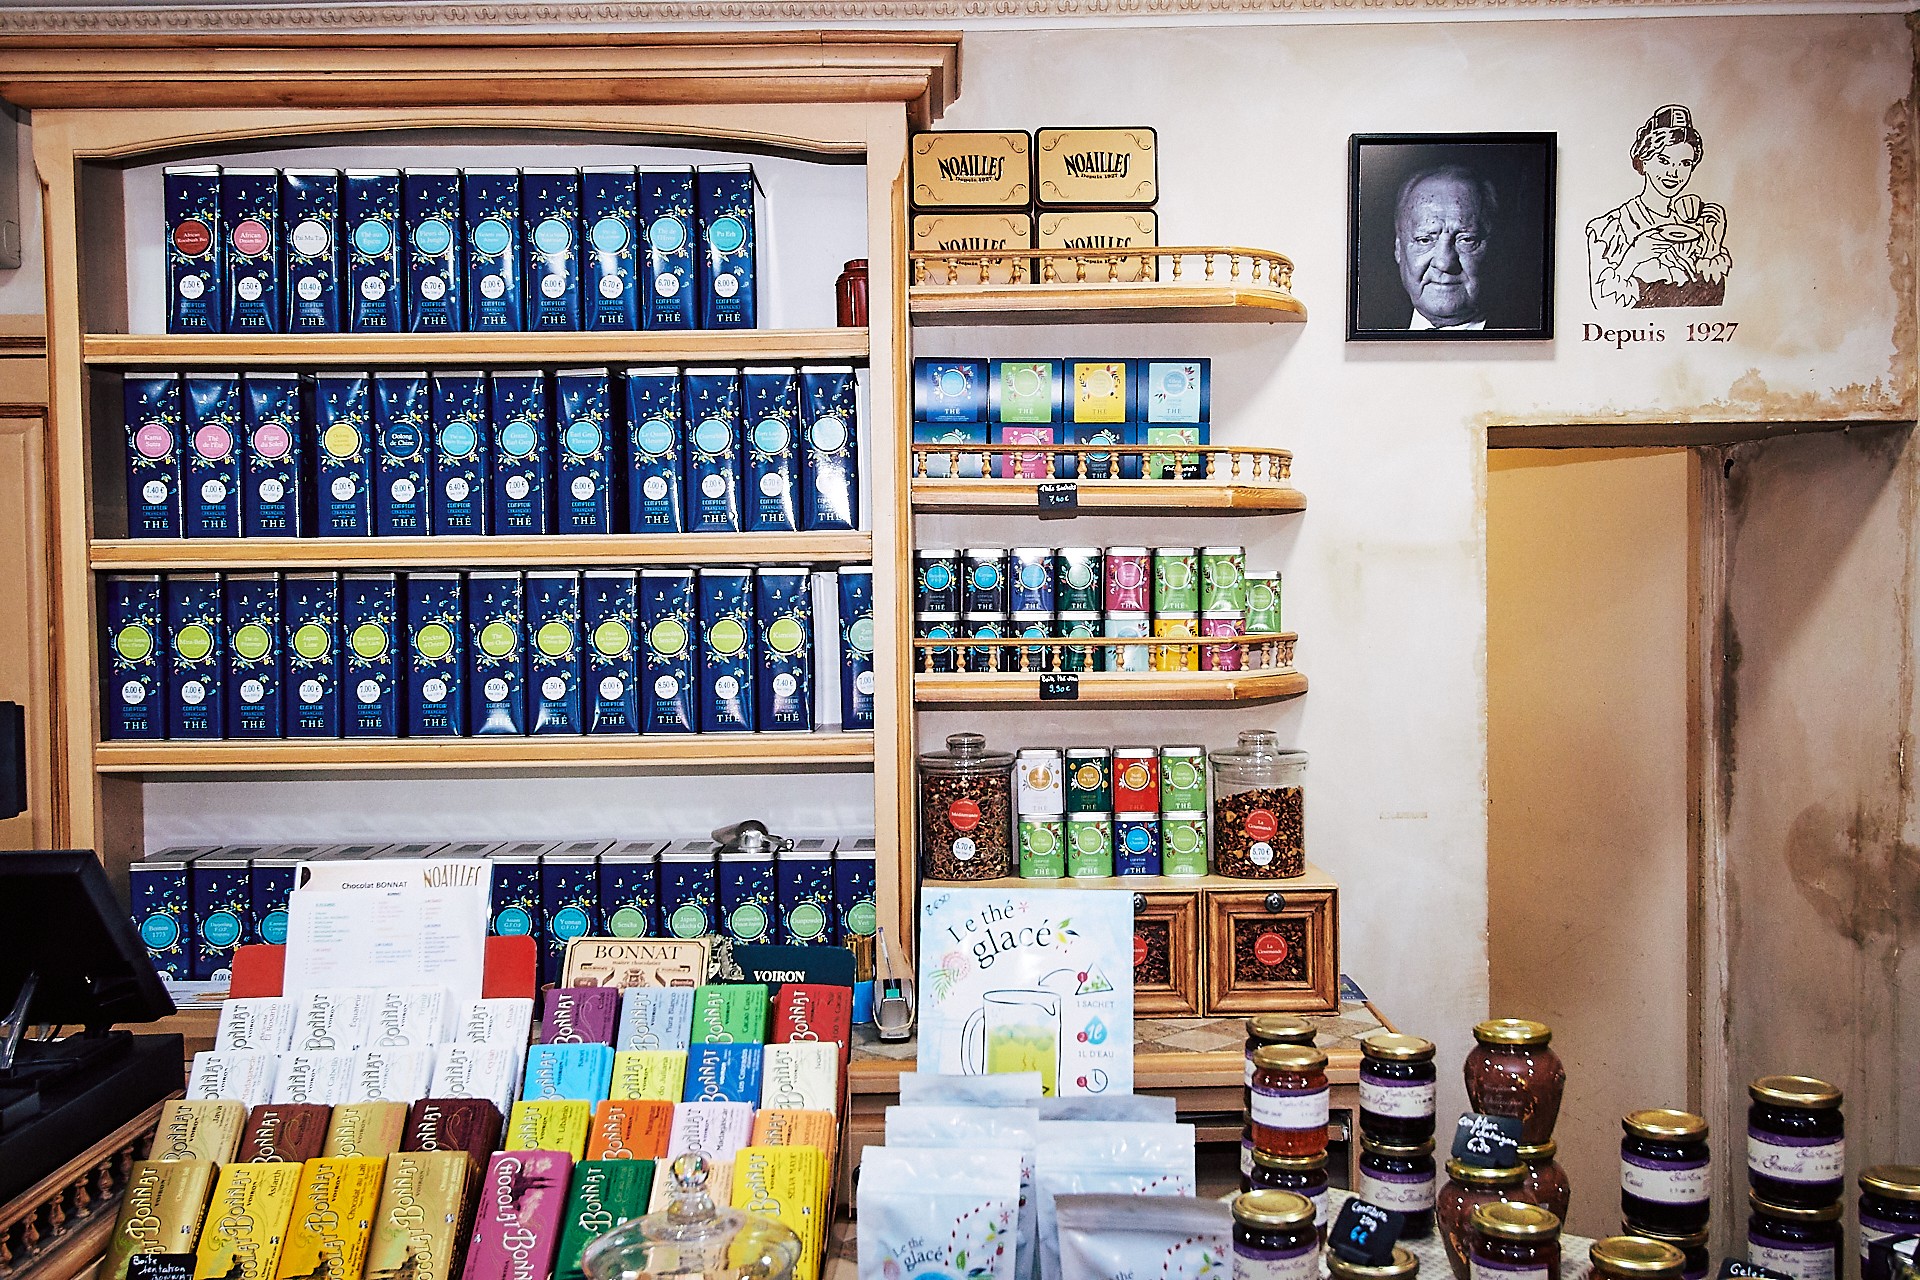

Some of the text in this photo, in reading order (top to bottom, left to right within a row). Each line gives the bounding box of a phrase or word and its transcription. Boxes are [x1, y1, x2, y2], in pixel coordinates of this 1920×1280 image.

[938, 155, 1005, 181] NOAILLES
[1063, 152, 1131, 178] NOAILLES
[182, 316, 206, 326] THÉ
[300, 316, 324, 326] THÉ
[362, 316, 386, 326] THÉ
[482, 314, 506, 324] THÉ
[600, 314, 624, 324] THÉ
[717, 313, 740, 322] THÉ
[1582, 322, 1738, 350] Depuis 1927
[144, 519, 168, 528] THÉ
[261, 518, 285, 528] THÉ
[392, 517, 416, 526] THÉ
[508, 516, 531, 526] THÉ
[572, 515, 596, 524] THÉ
[645, 514, 669, 523] THÉ
[423, 717, 447, 726] THÉ
[601, 713, 624, 724] THÉ
[776, 711, 799, 721] THÉ
[124, 720, 148, 729] THÉ
[242, 718, 266, 728] THÉ
[300, 718, 324, 728] THÉ
[424, 864, 481, 888] NOAILLES
[946, 900, 1014, 943] Le thé
[973, 919, 1051, 969] glacé
[595, 945, 682, 959] BONNAT
[754, 971, 805, 982] VOIRON
[213, 1105, 223, 1122] Java
[717, 1108, 728, 1150] Madagascar
[332, 1175, 341, 1202] VOIRON
[746, 1153, 780, 1216] BONNAT
[347, 1164, 366, 1220] Chocolat au Lait
[390, 1158, 425, 1228] BONNAT
[493, 1157, 521, 1228] CHOCOLAT
[125, 1167, 160, 1239] BONNAT
[219, 1169, 254, 1236] BONNAT
[304, 1164, 339, 1233] BONNAT
[579, 1167, 612, 1232] BONNAT
[908, 1236, 924, 1248] thé
[904, 1246, 943, 1272] glacé
